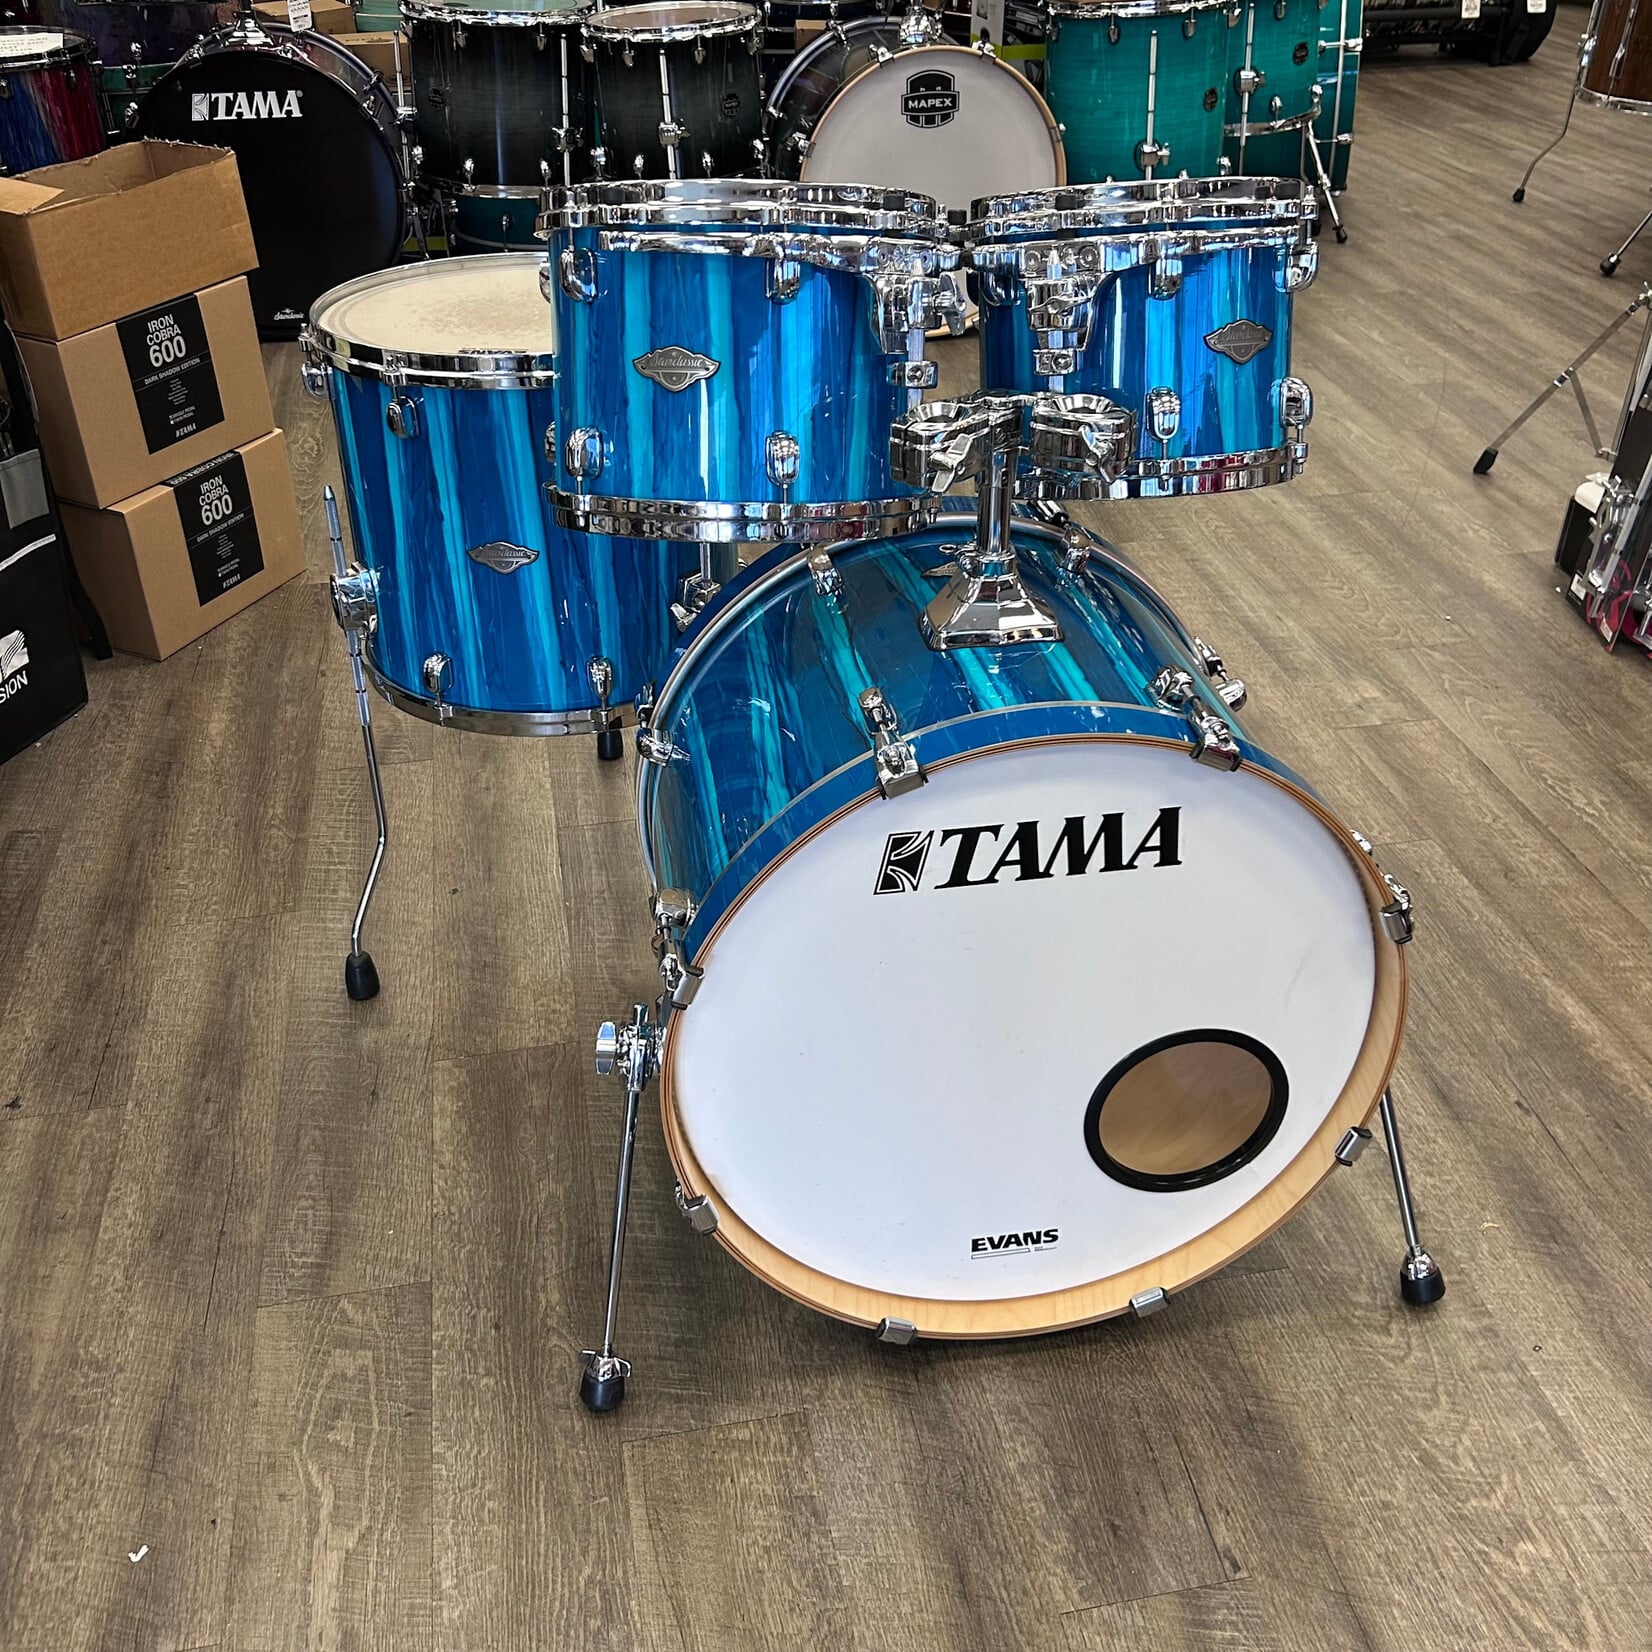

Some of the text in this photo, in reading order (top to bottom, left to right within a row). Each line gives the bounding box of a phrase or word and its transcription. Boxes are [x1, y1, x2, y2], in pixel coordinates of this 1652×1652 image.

[211, 90, 303, 120] TAMA
[908, 97, 953, 109] MAPEX
[146, 324, 181, 346] COBRA
[148, 314, 174, 333] IRON
[149, 335, 186, 368] 600
[144, 357, 201, 385] DARK SHADOW EDITION
[199, 484, 229, 506] COBRA
[200, 475, 223, 494] IRON
[201, 495, 233, 526] 600
[934, 806, 1183, 890] TAMA
[971, 1228, 1059, 1252] EVANS
